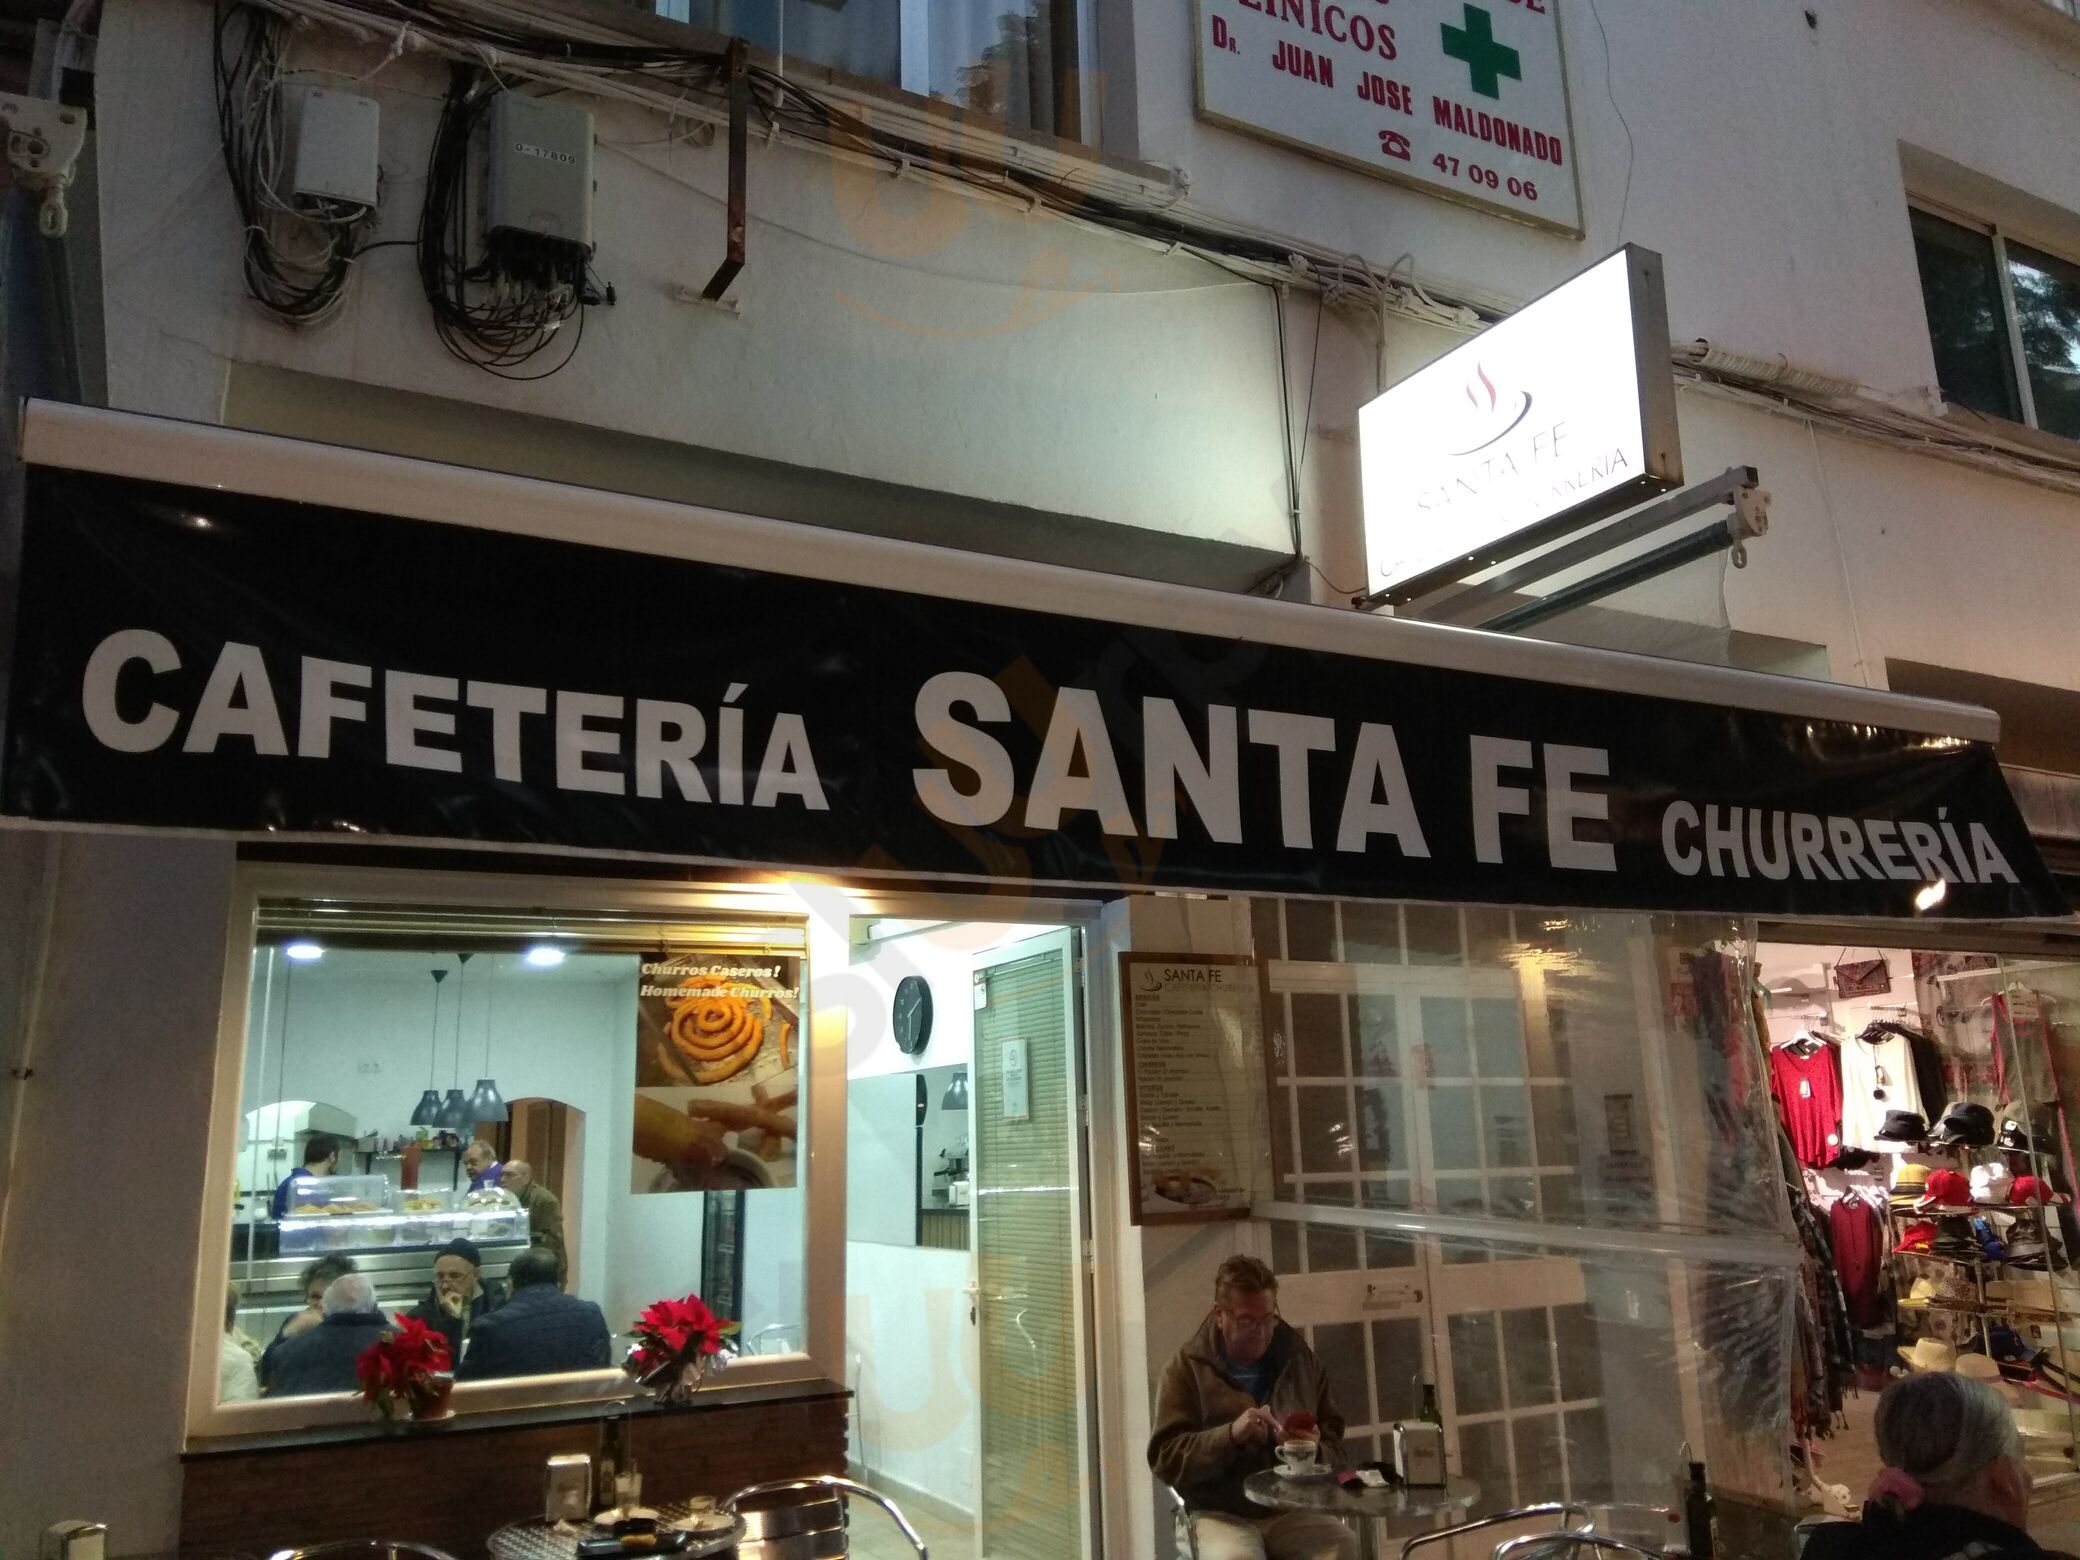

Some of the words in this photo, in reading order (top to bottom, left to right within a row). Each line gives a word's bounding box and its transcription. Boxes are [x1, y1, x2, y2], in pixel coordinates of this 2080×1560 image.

[1272, 40, 1334, 89] JUAN
[1357, 71, 1413, 116] JOSE
[1433, 96, 1563, 166] MALDONADO
[1433, 153, 1460, 177] 47
[1468, 164, 1499, 190] 09
[1507, 176, 1538, 201] 06
[1532, 420, 1568, 464] FE
[82, 628, 830, 811] CAFETERÍA
[912, 670, 1432, 858] SANTA
[1469, 734, 1617, 872] FE
[1661, 800, 2021, 884] CHURRERÍA
[640, 985, 727, 998] Homemade
[730, 986, 800, 999] Churros!
[641, 963, 708, 976] Churros
[1164, 968, 1205, 982] SANTA
[1208, 969, 1222, 983] FE
